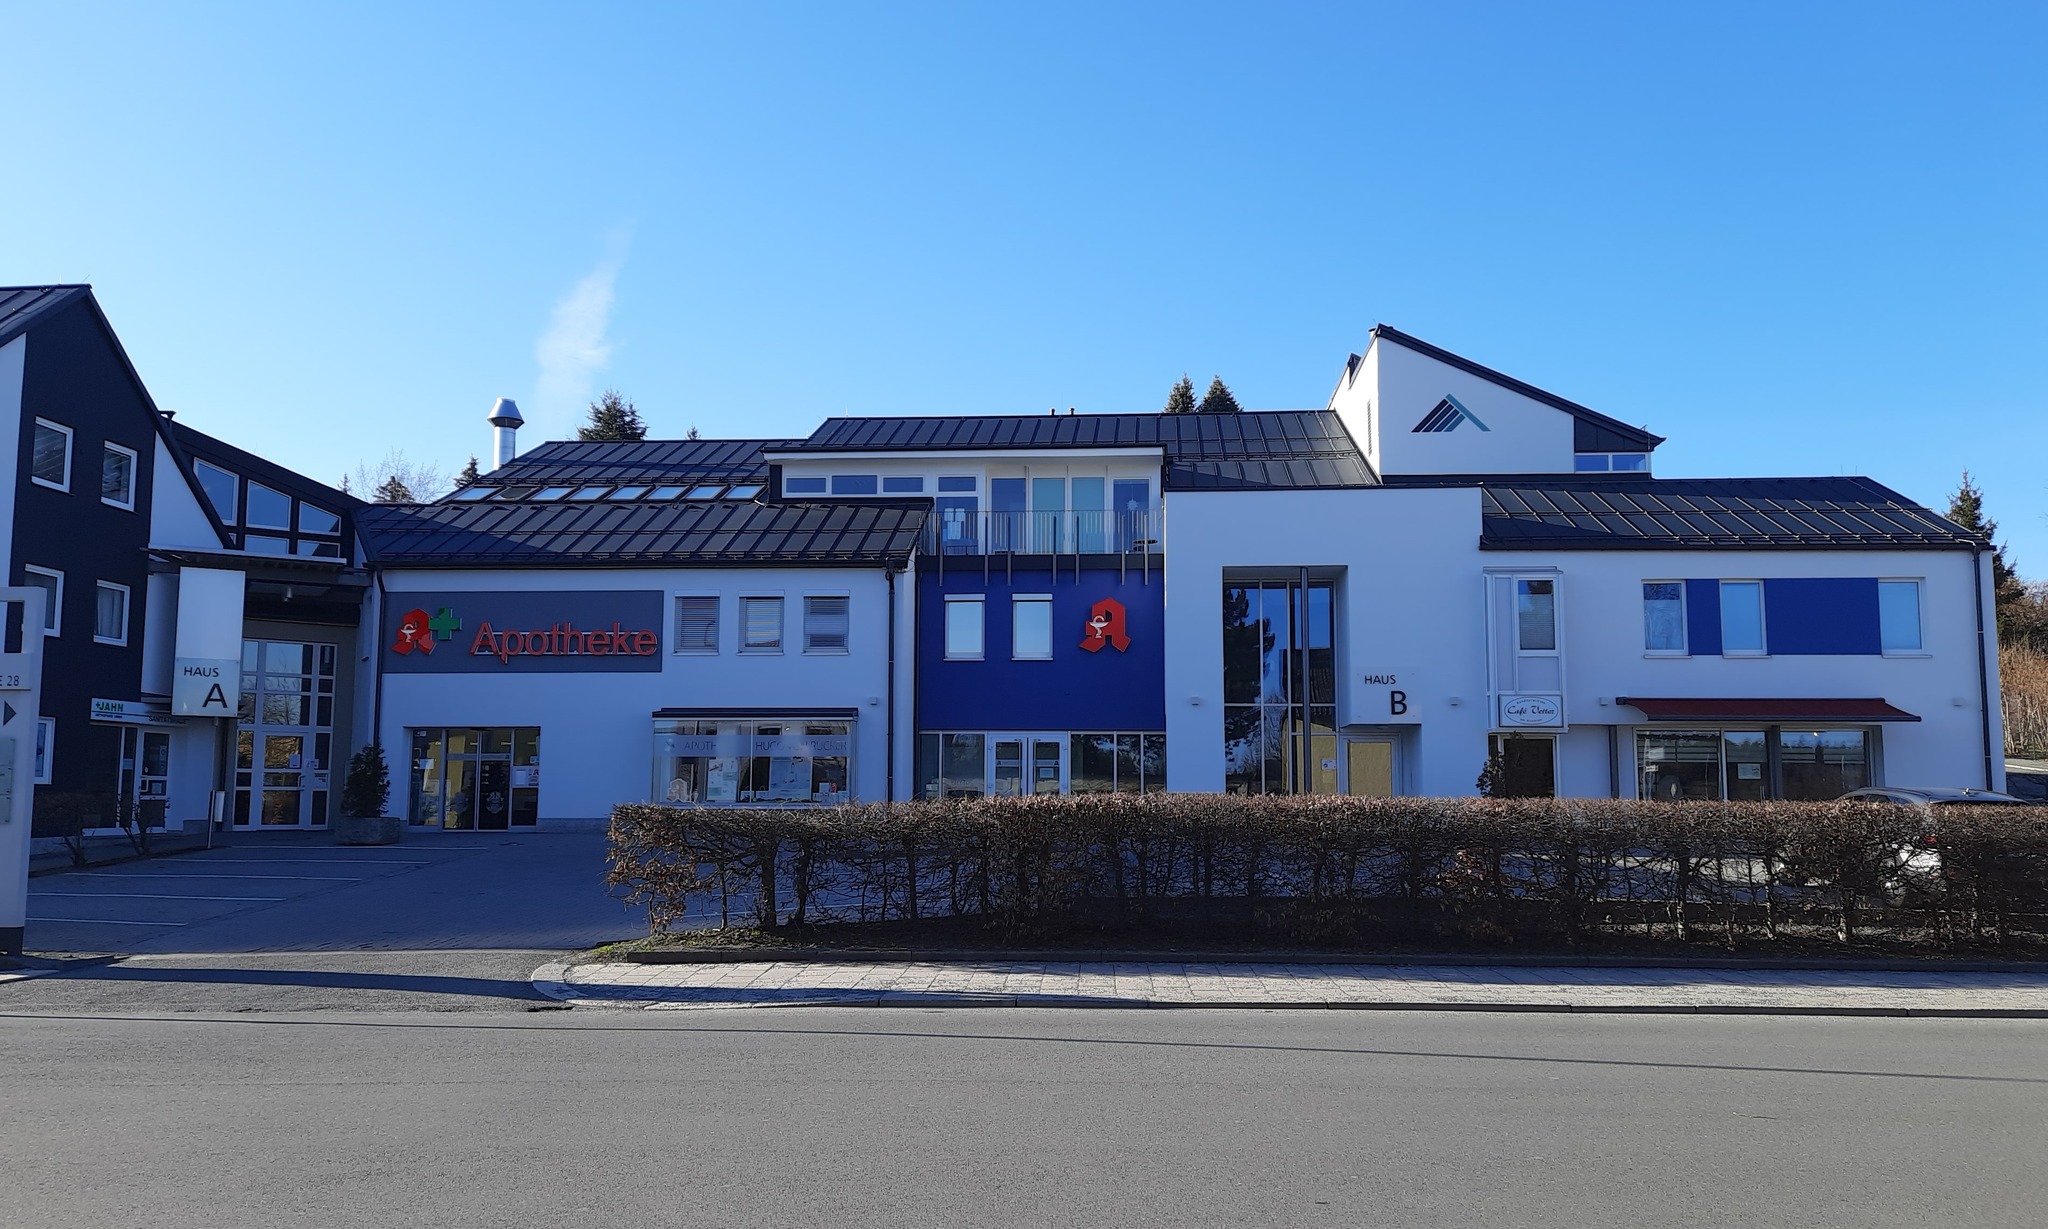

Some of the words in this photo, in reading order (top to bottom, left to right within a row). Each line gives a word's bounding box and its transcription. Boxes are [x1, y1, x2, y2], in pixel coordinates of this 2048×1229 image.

[469, 622, 658, 664] Apotheke
[183, 666, 219, 677] HAUS
[6, 675, 20, 687] 28
[1364, 675, 1396, 685] HAUS
[202, 683, 228, 708] A
[99, 701, 124, 713] JAHN
[1390, 690, 1408, 715] B
[1507, 705, 1528, 716] Café
